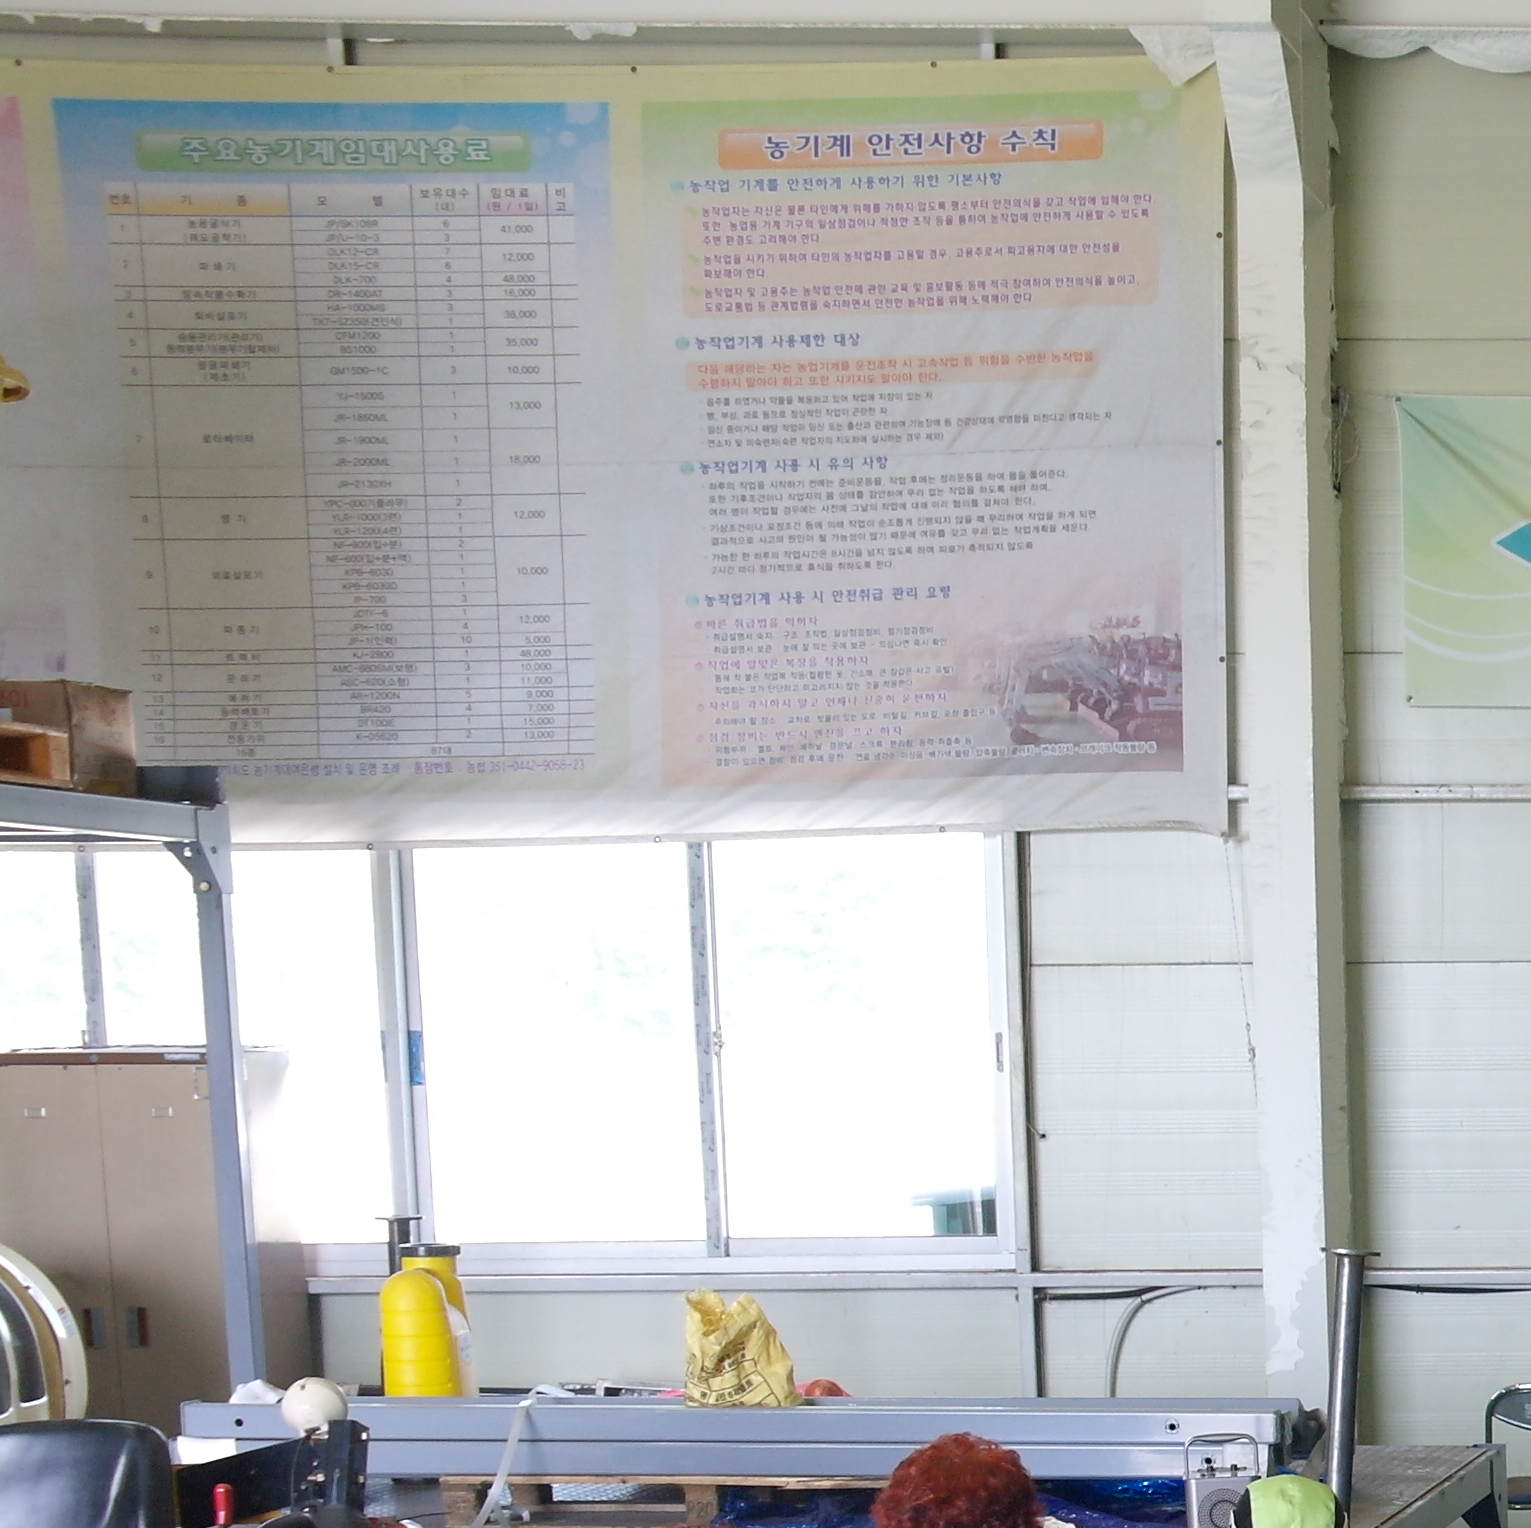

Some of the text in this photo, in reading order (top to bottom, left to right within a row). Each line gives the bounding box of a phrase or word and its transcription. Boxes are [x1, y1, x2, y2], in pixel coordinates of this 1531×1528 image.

[764, 127, 1058, 159] 농기계 안전사항 수칙
[181, 137, 492, 165] 주요농기계임대사용료
[690, 172, 1002, 192] 농작업 기계를 안전하게 사용하기 위한 기본사항
[420, 188, 470, 200] 보유대수
[490, 187, 530, 200] 임대료
[500, 225, 533, 234] 41,000
[502, 253, 534, 262] 12,000
[503, 274, 535, 283] 48,000
[504, 288, 535, 297] 16,000
[506, 338, 538, 347] 35,000
[695, 333, 860, 350] 농작업기계 사용제한 대상
[508, 366, 539, 374] 10,000
[509, 401, 541, 410] 13,000
[509, 455, 541, 464] 18,000
[699, 456, 888, 474] 농작업기계 사용 시 유의 사항
[514, 510, 545, 520] 12,000
[517, 567, 548, 576] 10,000
[705, 585, 951, 608] 농작업기계 사용 시 안전취급 관리 요령
[519, 614, 550, 625] 12,000
[525, 635, 551, 645] 5,000
[520, 649, 551, 659] 48,000
[522, 662, 551, 672] 10,000
[521, 676, 552, 686] 11,000
[528, 703, 554, 712] 7,000
[523, 716, 554, 726] 15,000
[524, 730, 554, 740] 13,000
